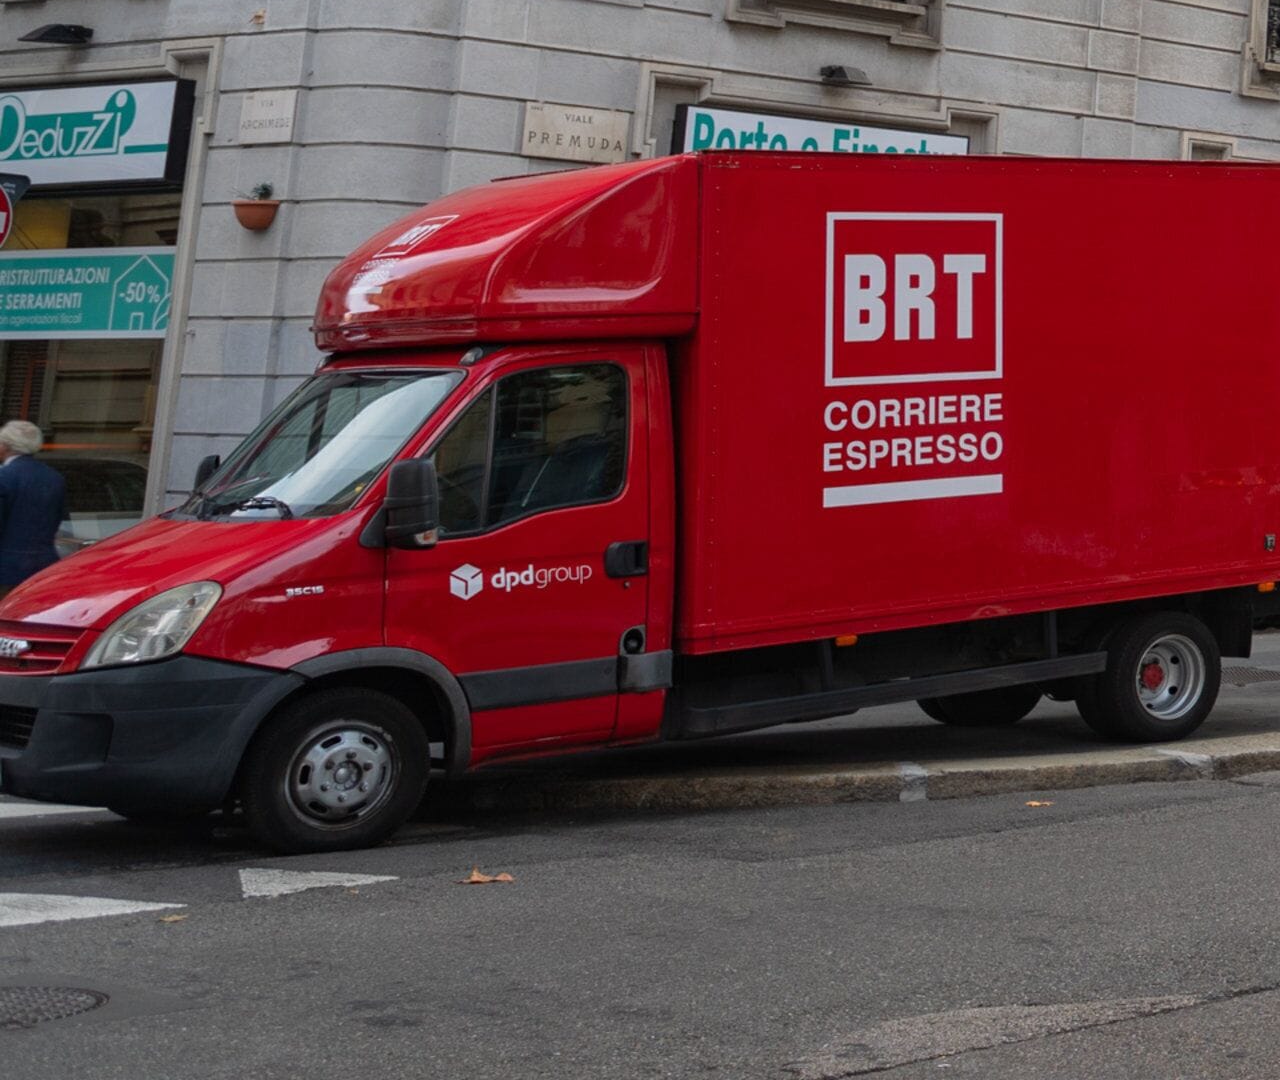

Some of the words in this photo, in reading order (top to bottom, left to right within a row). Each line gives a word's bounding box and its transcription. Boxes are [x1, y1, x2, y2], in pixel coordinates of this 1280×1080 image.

[565, 113, 593, 124] VIALE
[528, 131, 623, 151] PREMUDA
[0, 267, 111, 287] RISTRUTTURAZIONI
[6, 292, 83, 309] SERRAMENTI
[844, 253, 986, 342] BRT
[823, 393, 1003, 431] CORRIERE
[823, 431, 1003, 472] ESPRESSO
[491, 564, 593, 593] dpdgroup
